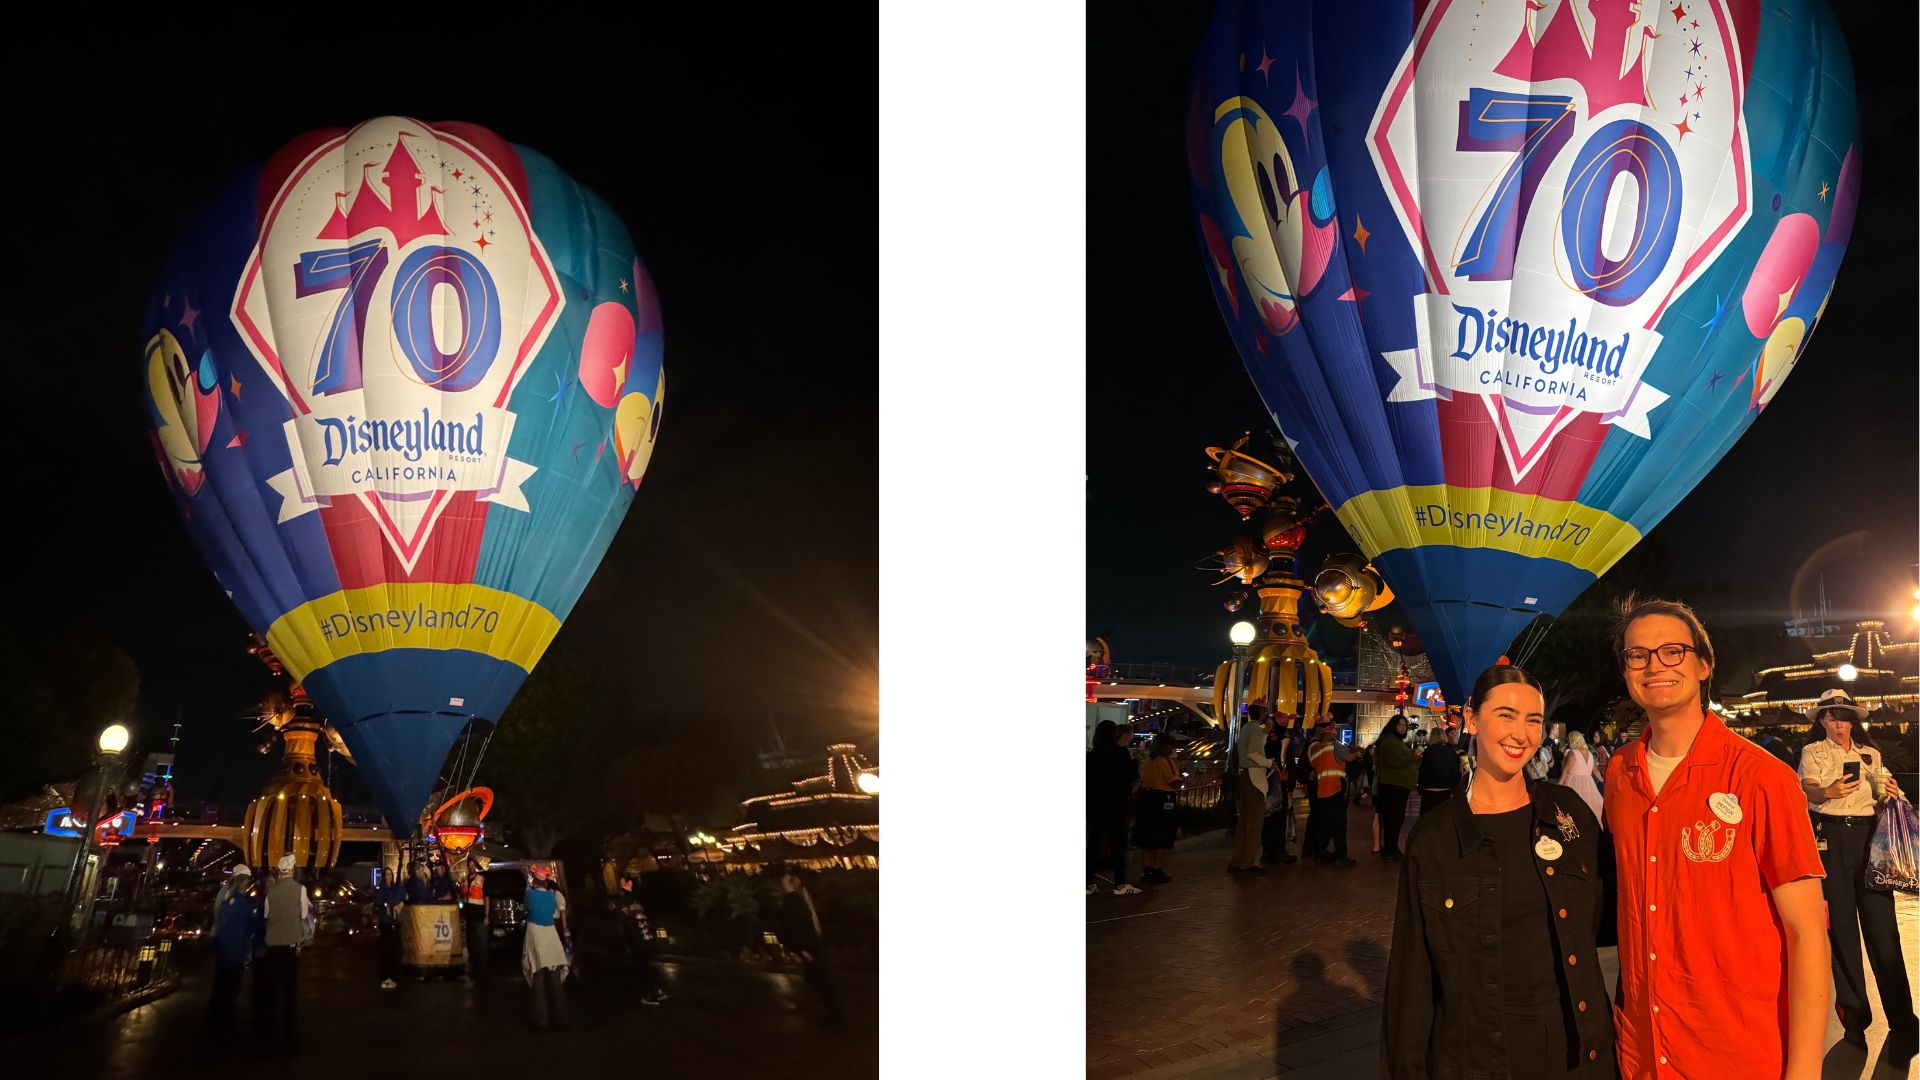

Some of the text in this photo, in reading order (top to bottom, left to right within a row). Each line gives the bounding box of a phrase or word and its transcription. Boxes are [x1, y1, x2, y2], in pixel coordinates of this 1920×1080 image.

[1451, 87, 1683, 307] 70
[294, 238, 501, 397] 70
[1450, 301, 1630, 378] Disneyland
[1479, 369, 1588, 402] CALIFORNIA
[1583, 371, 1617, 386] RESORT
[314, 407, 484, 467] Disneyland
[351, 467, 457, 485] CALIFORNIA
[448, 454, 481, 464] RESORT
[1415, 504, 1591, 547] #Disneyland70
[320, 602, 499, 641] #Disneyland70
[434, 924, 450, 938] 70
